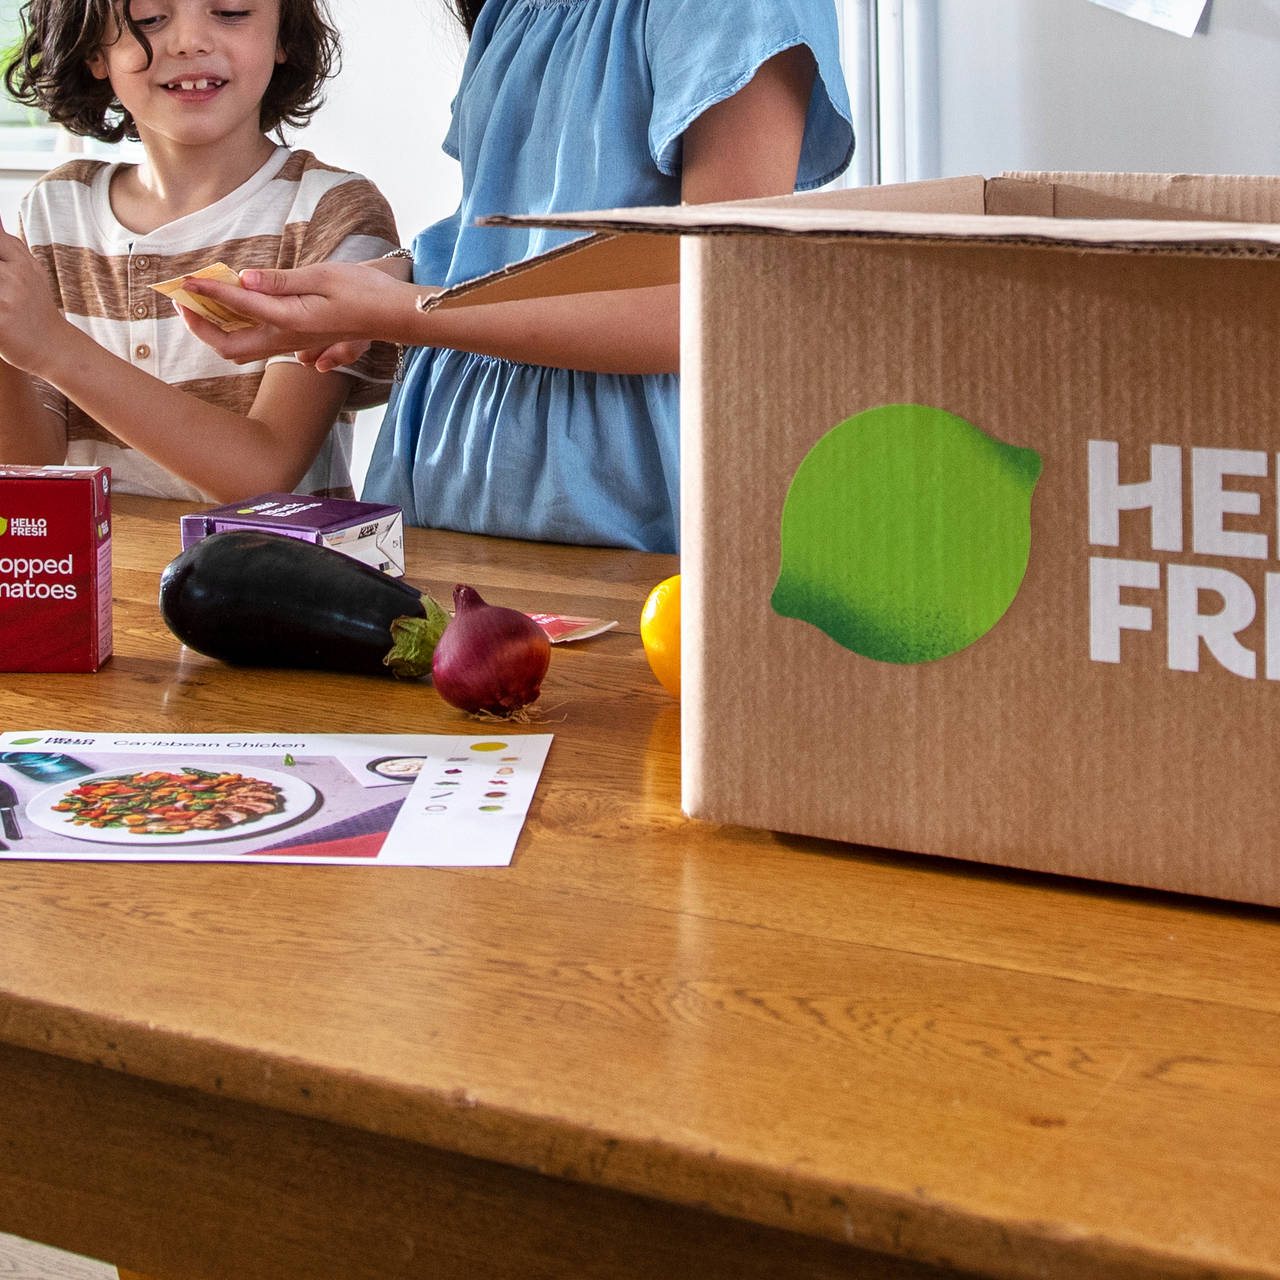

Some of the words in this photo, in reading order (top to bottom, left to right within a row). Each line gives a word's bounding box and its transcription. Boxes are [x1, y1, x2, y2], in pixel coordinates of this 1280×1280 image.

[10, 517, 48, 528] HELLO
[10, 526, 48, 537] FRESH
[113, 740, 220, 748] Caribbean
